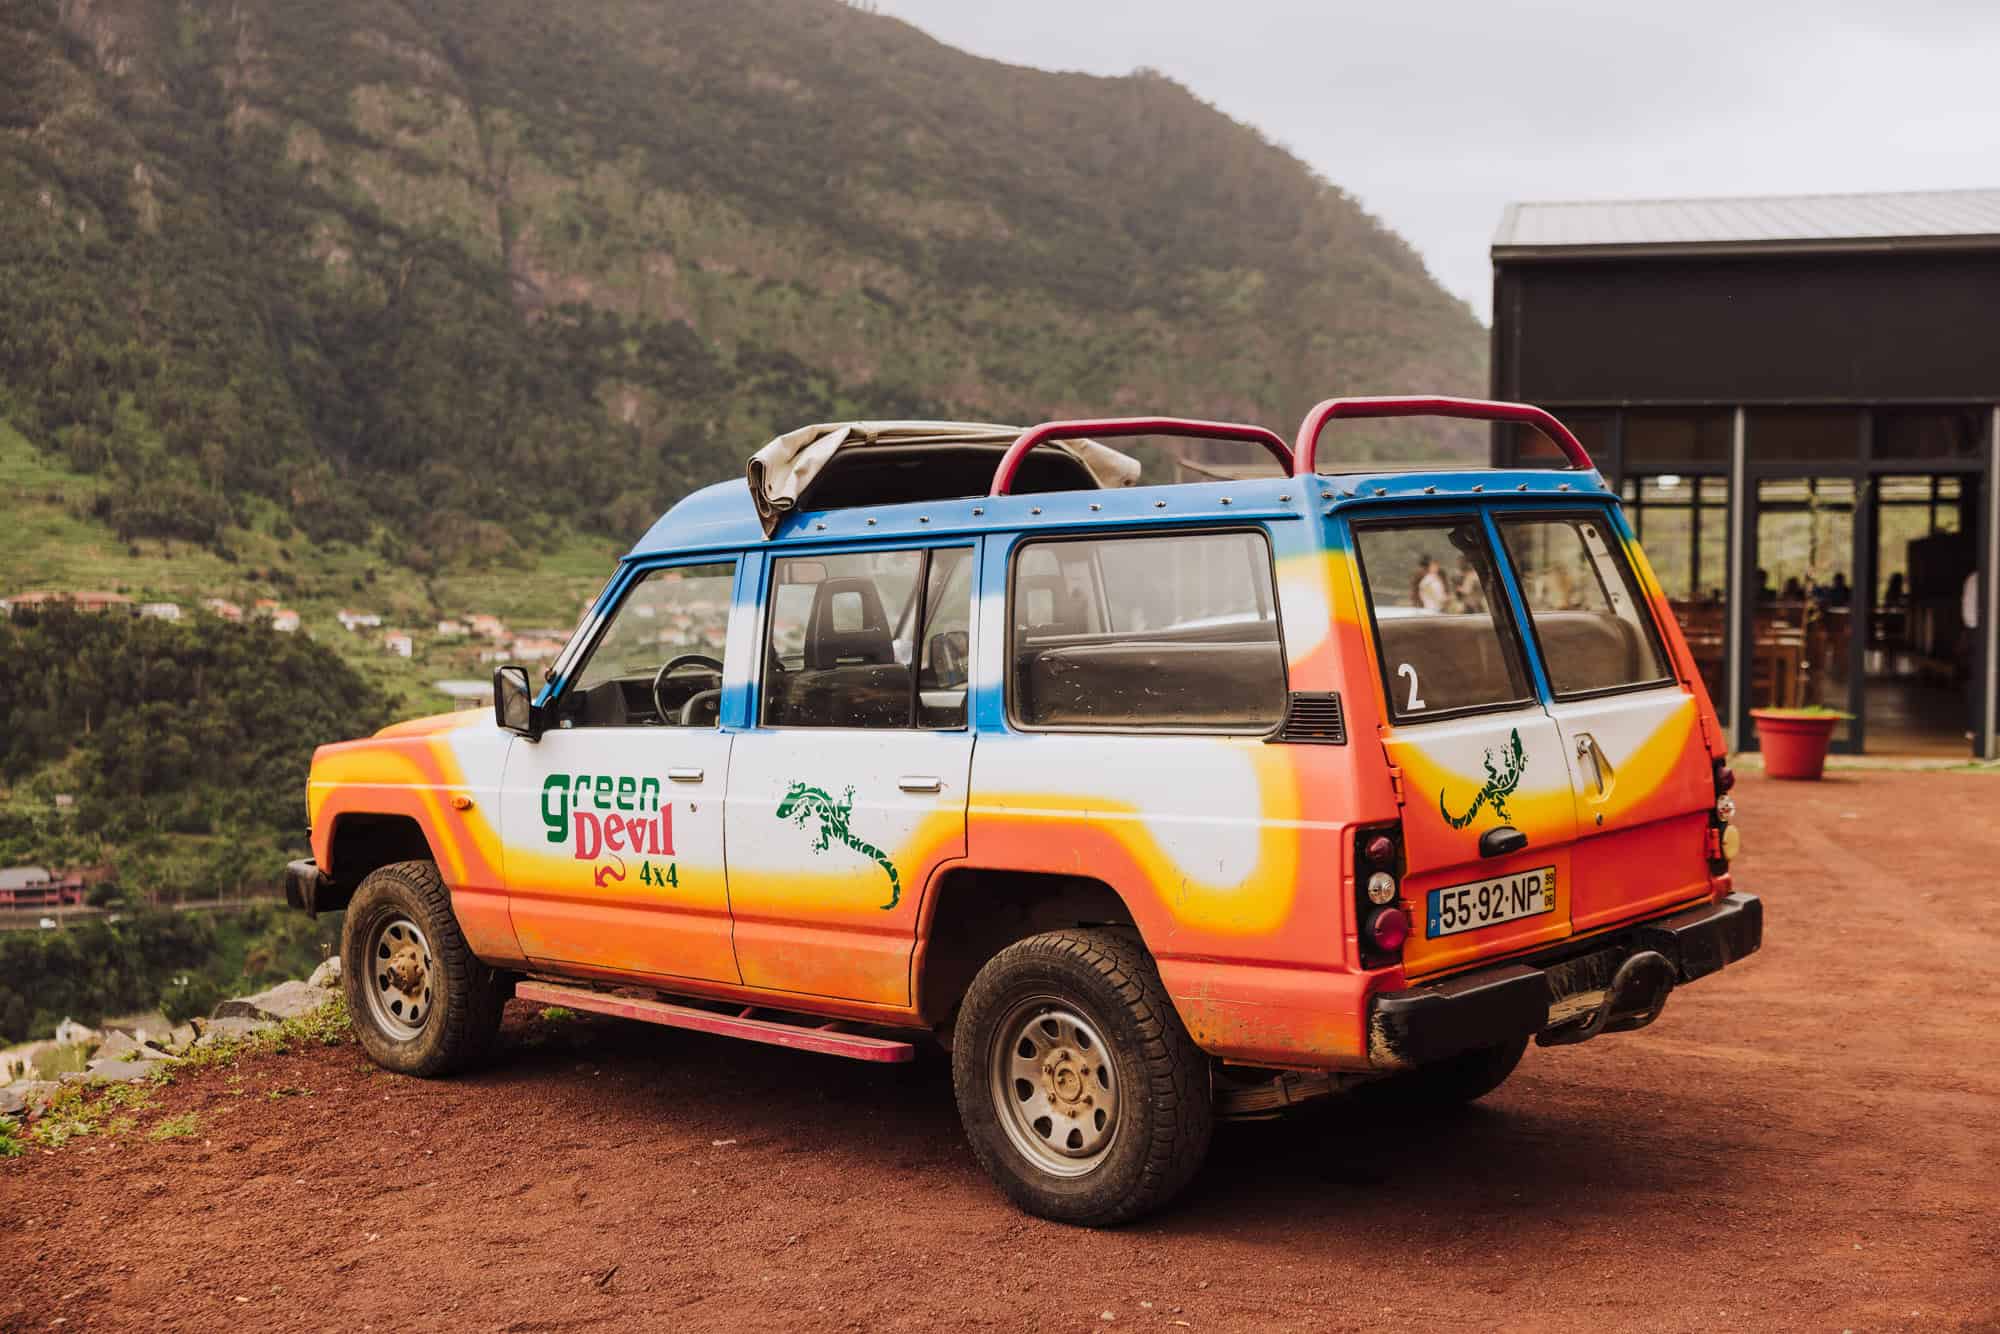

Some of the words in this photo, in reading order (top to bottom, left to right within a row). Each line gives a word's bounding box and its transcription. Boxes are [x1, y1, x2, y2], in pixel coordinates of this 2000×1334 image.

[1397, 663, 1426, 710] 2
[541, 774, 661, 843] green
[573, 802, 676, 860] Devil
[639, 860, 679, 888] 4x4
